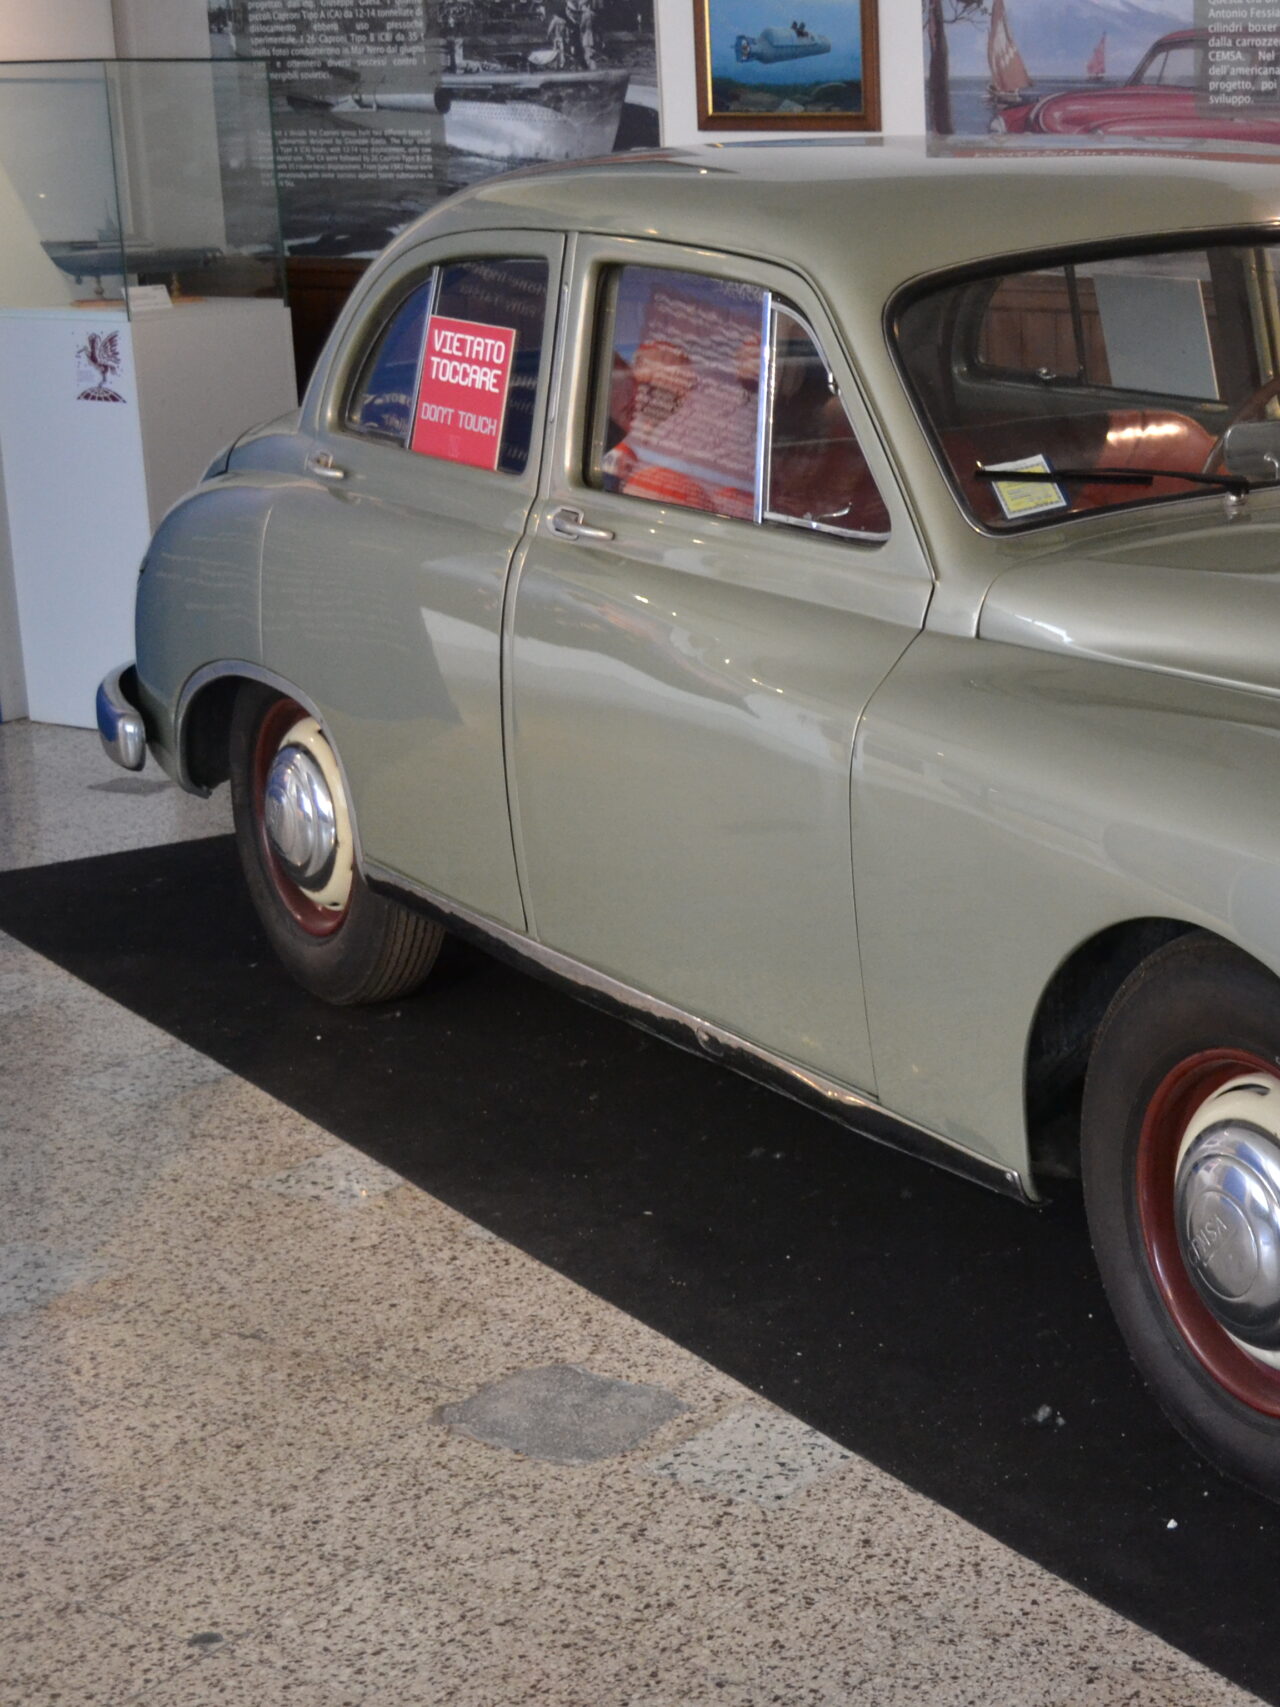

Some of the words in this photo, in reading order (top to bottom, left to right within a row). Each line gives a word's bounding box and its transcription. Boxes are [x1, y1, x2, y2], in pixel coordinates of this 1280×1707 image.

[1208, 8, 1247, 18] Antonio
[1208, 22, 1243, 33] cilindri
[1248, 22, 1278, 32] boxer
[1208, 37, 1232, 47] dalla
[1208, 50, 1245, 60] CEMSA.
[1258, 50, 1275, 60] Nel
[1208, 65, 1280, 75] dell'americana
[1208, 80, 1255, 92] progetto,
[1261, 79, 1277, 92] poi
[1208, 93, 1255, 106] sviluppo.
[434, 329, 506, 364] VIETATO
[430, 356, 502, 393] TOCCARE
[421, 402, 455, 425] DON'T
[458, 410, 497, 437] TOUCH
